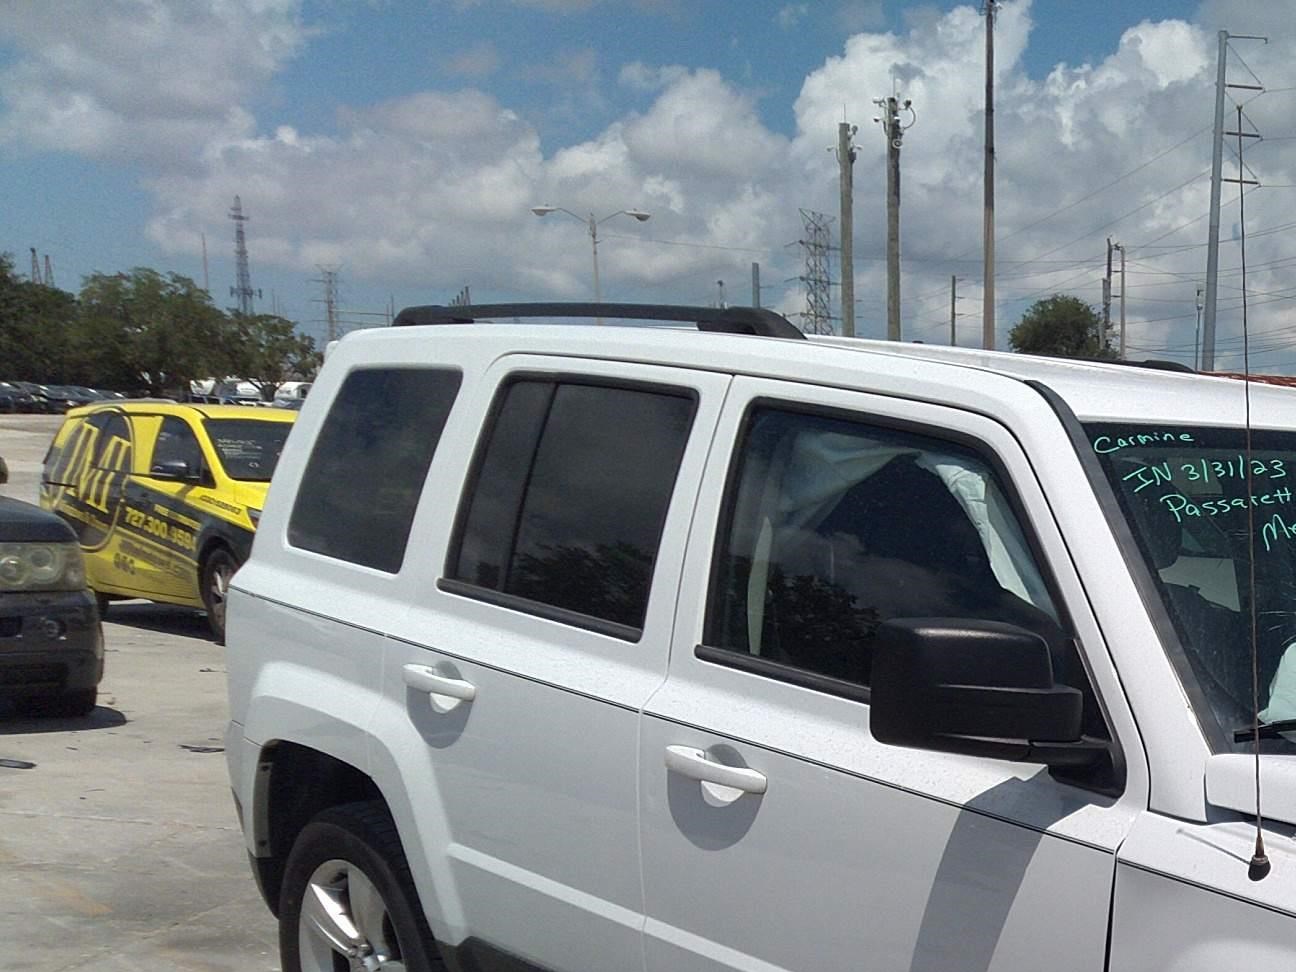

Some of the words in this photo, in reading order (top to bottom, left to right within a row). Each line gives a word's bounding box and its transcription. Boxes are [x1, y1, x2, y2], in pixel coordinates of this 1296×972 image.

[1093, 431, 1195, 454] Carmine
[1122, 462, 1172, 492] IN
[1180, 454, 1287, 483] 3/31/23
